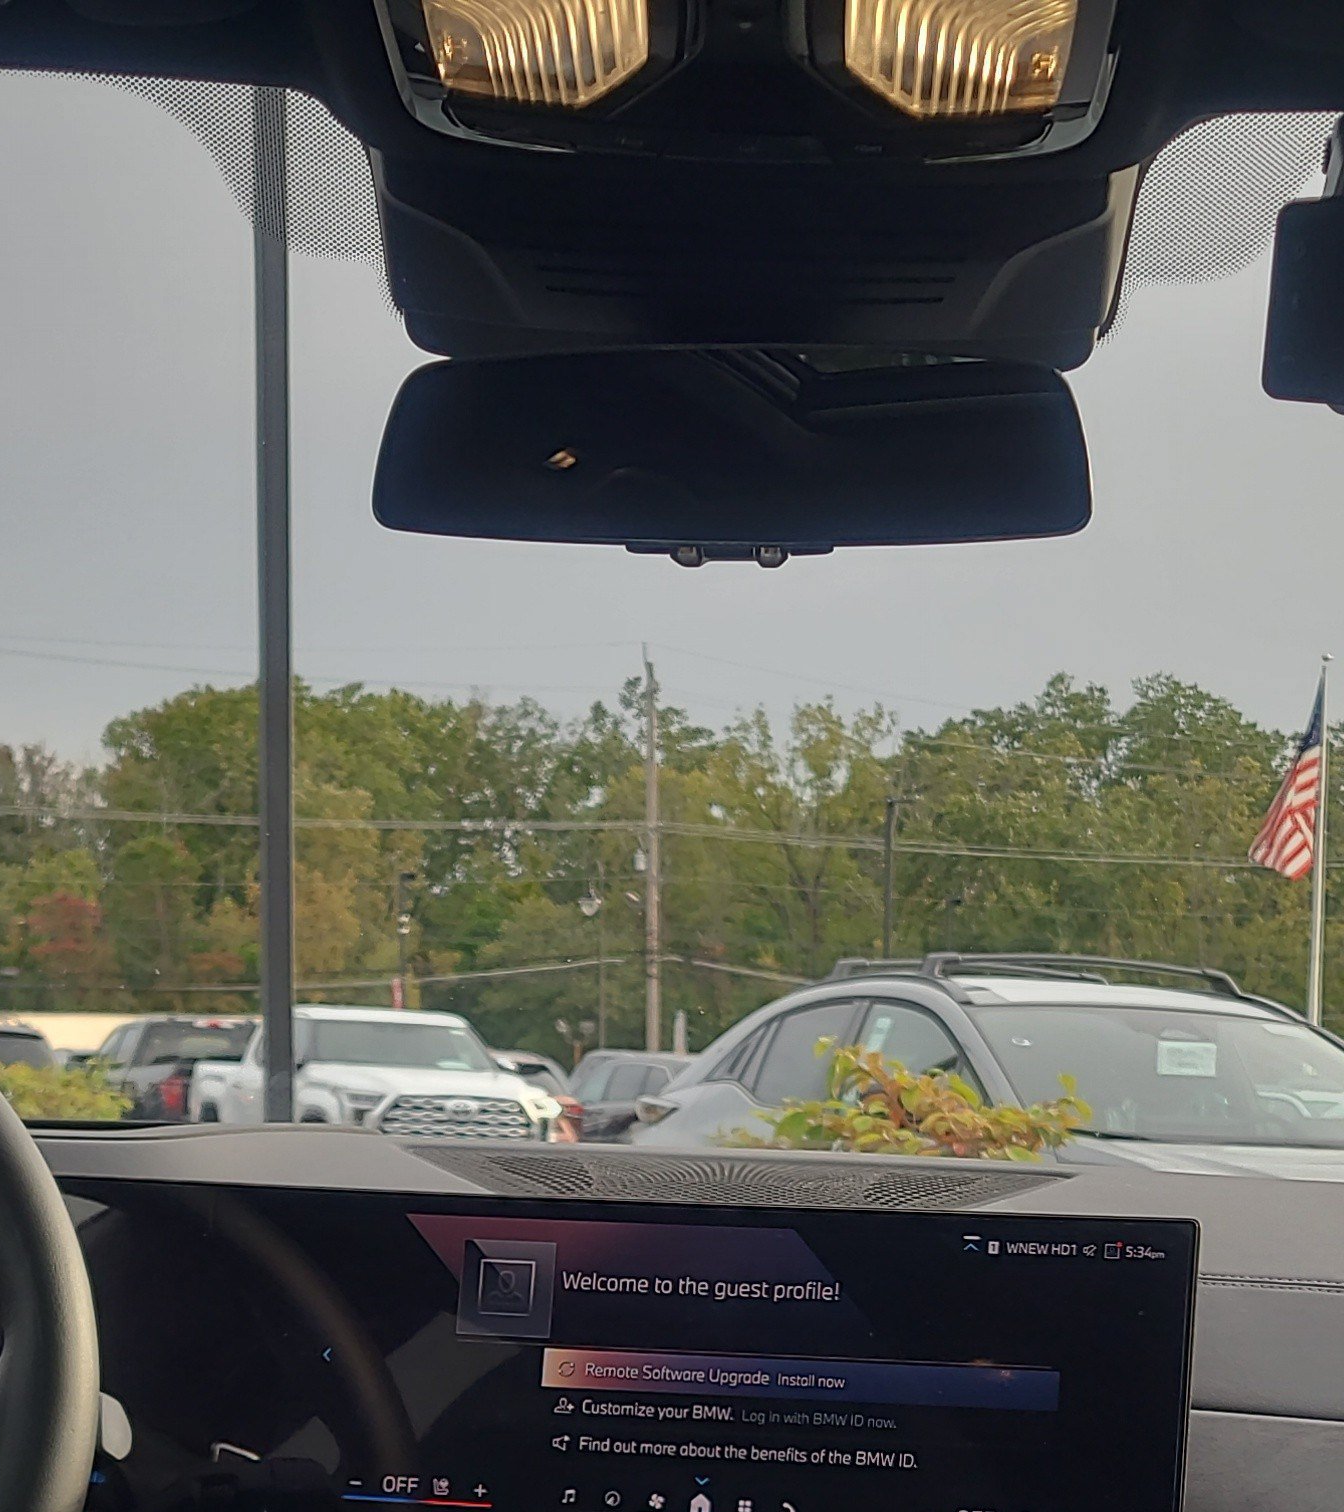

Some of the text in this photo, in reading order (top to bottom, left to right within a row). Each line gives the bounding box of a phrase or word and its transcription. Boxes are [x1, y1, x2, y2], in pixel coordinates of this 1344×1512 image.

[1006, 1242, 1048, 1256] WNEW
[1051, 1243, 1076, 1257] HD1
[1125, 1246, 1165, 1260] 5:34pm
[562, 1271, 841, 1302] Welcome to the guest profile!
[585, 1363, 845, 1388] Remote Software Upgrade Install now
[582, 1400, 897, 1430] Customize your BMW. Log in with BMW ID now.
[580, 1436, 918, 1468] Find out more about the benefits of the BMW ID.
[382, 1475, 419, 1494] OFF
